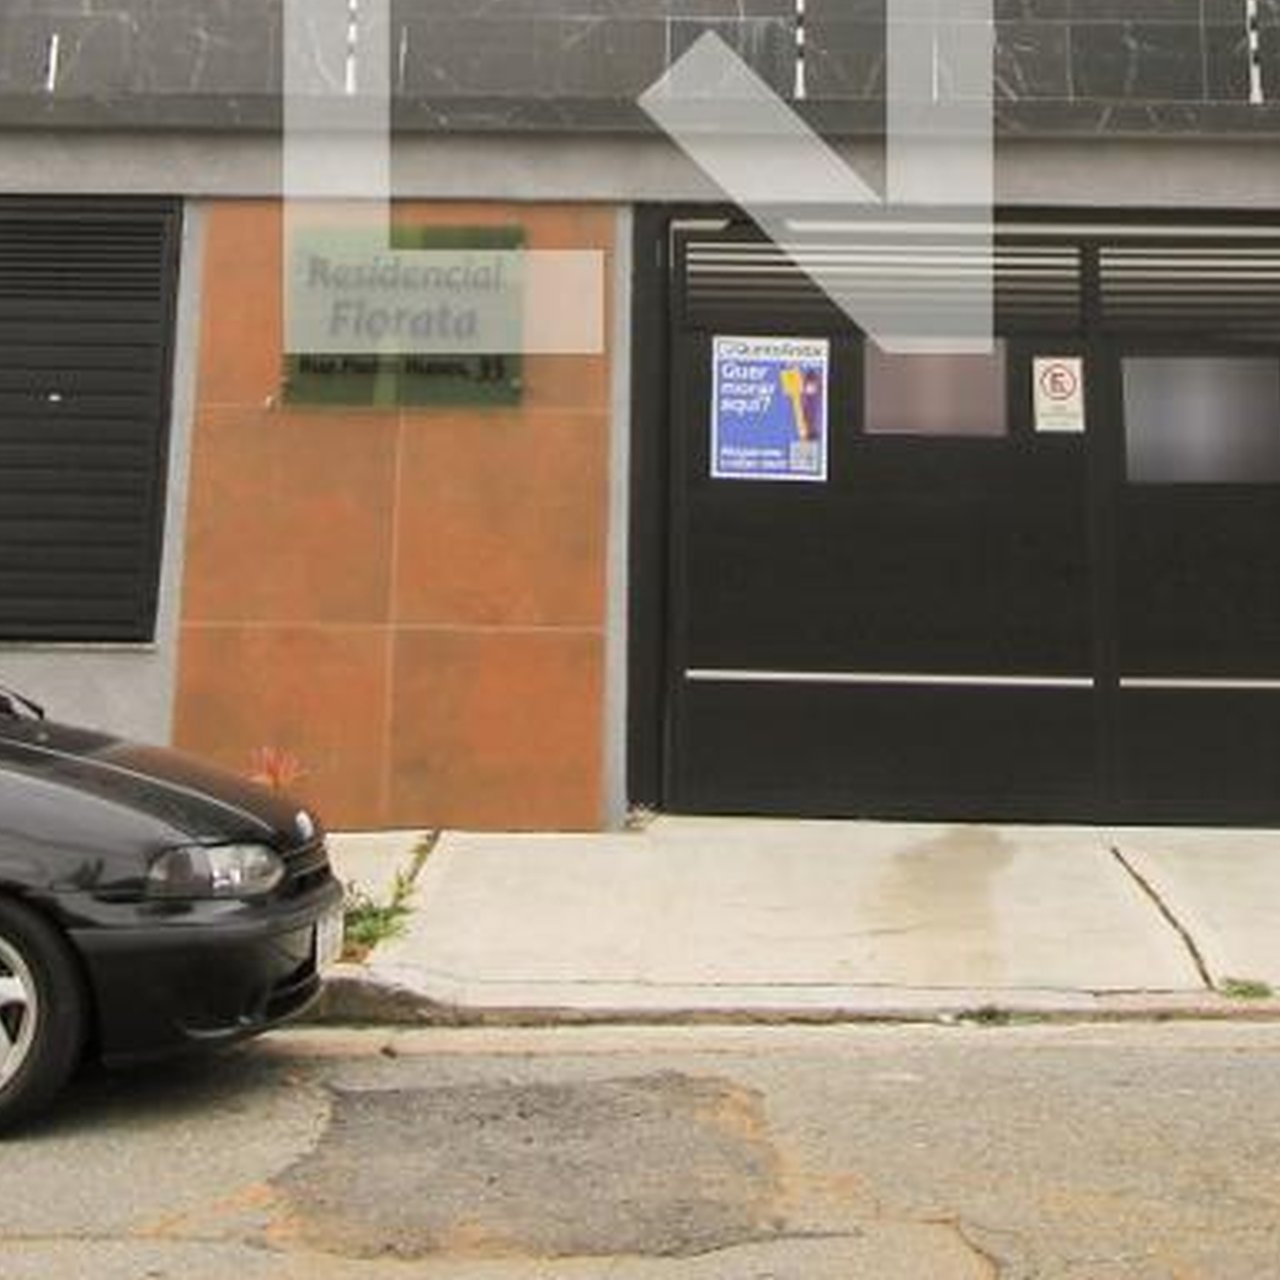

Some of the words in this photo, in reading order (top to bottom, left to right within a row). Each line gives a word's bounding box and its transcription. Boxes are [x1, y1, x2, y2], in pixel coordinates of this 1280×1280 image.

[306, 255, 505, 291] Residencial
[328, 299, 479, 339] Florata
[721, 364, 768, 379] Quer
